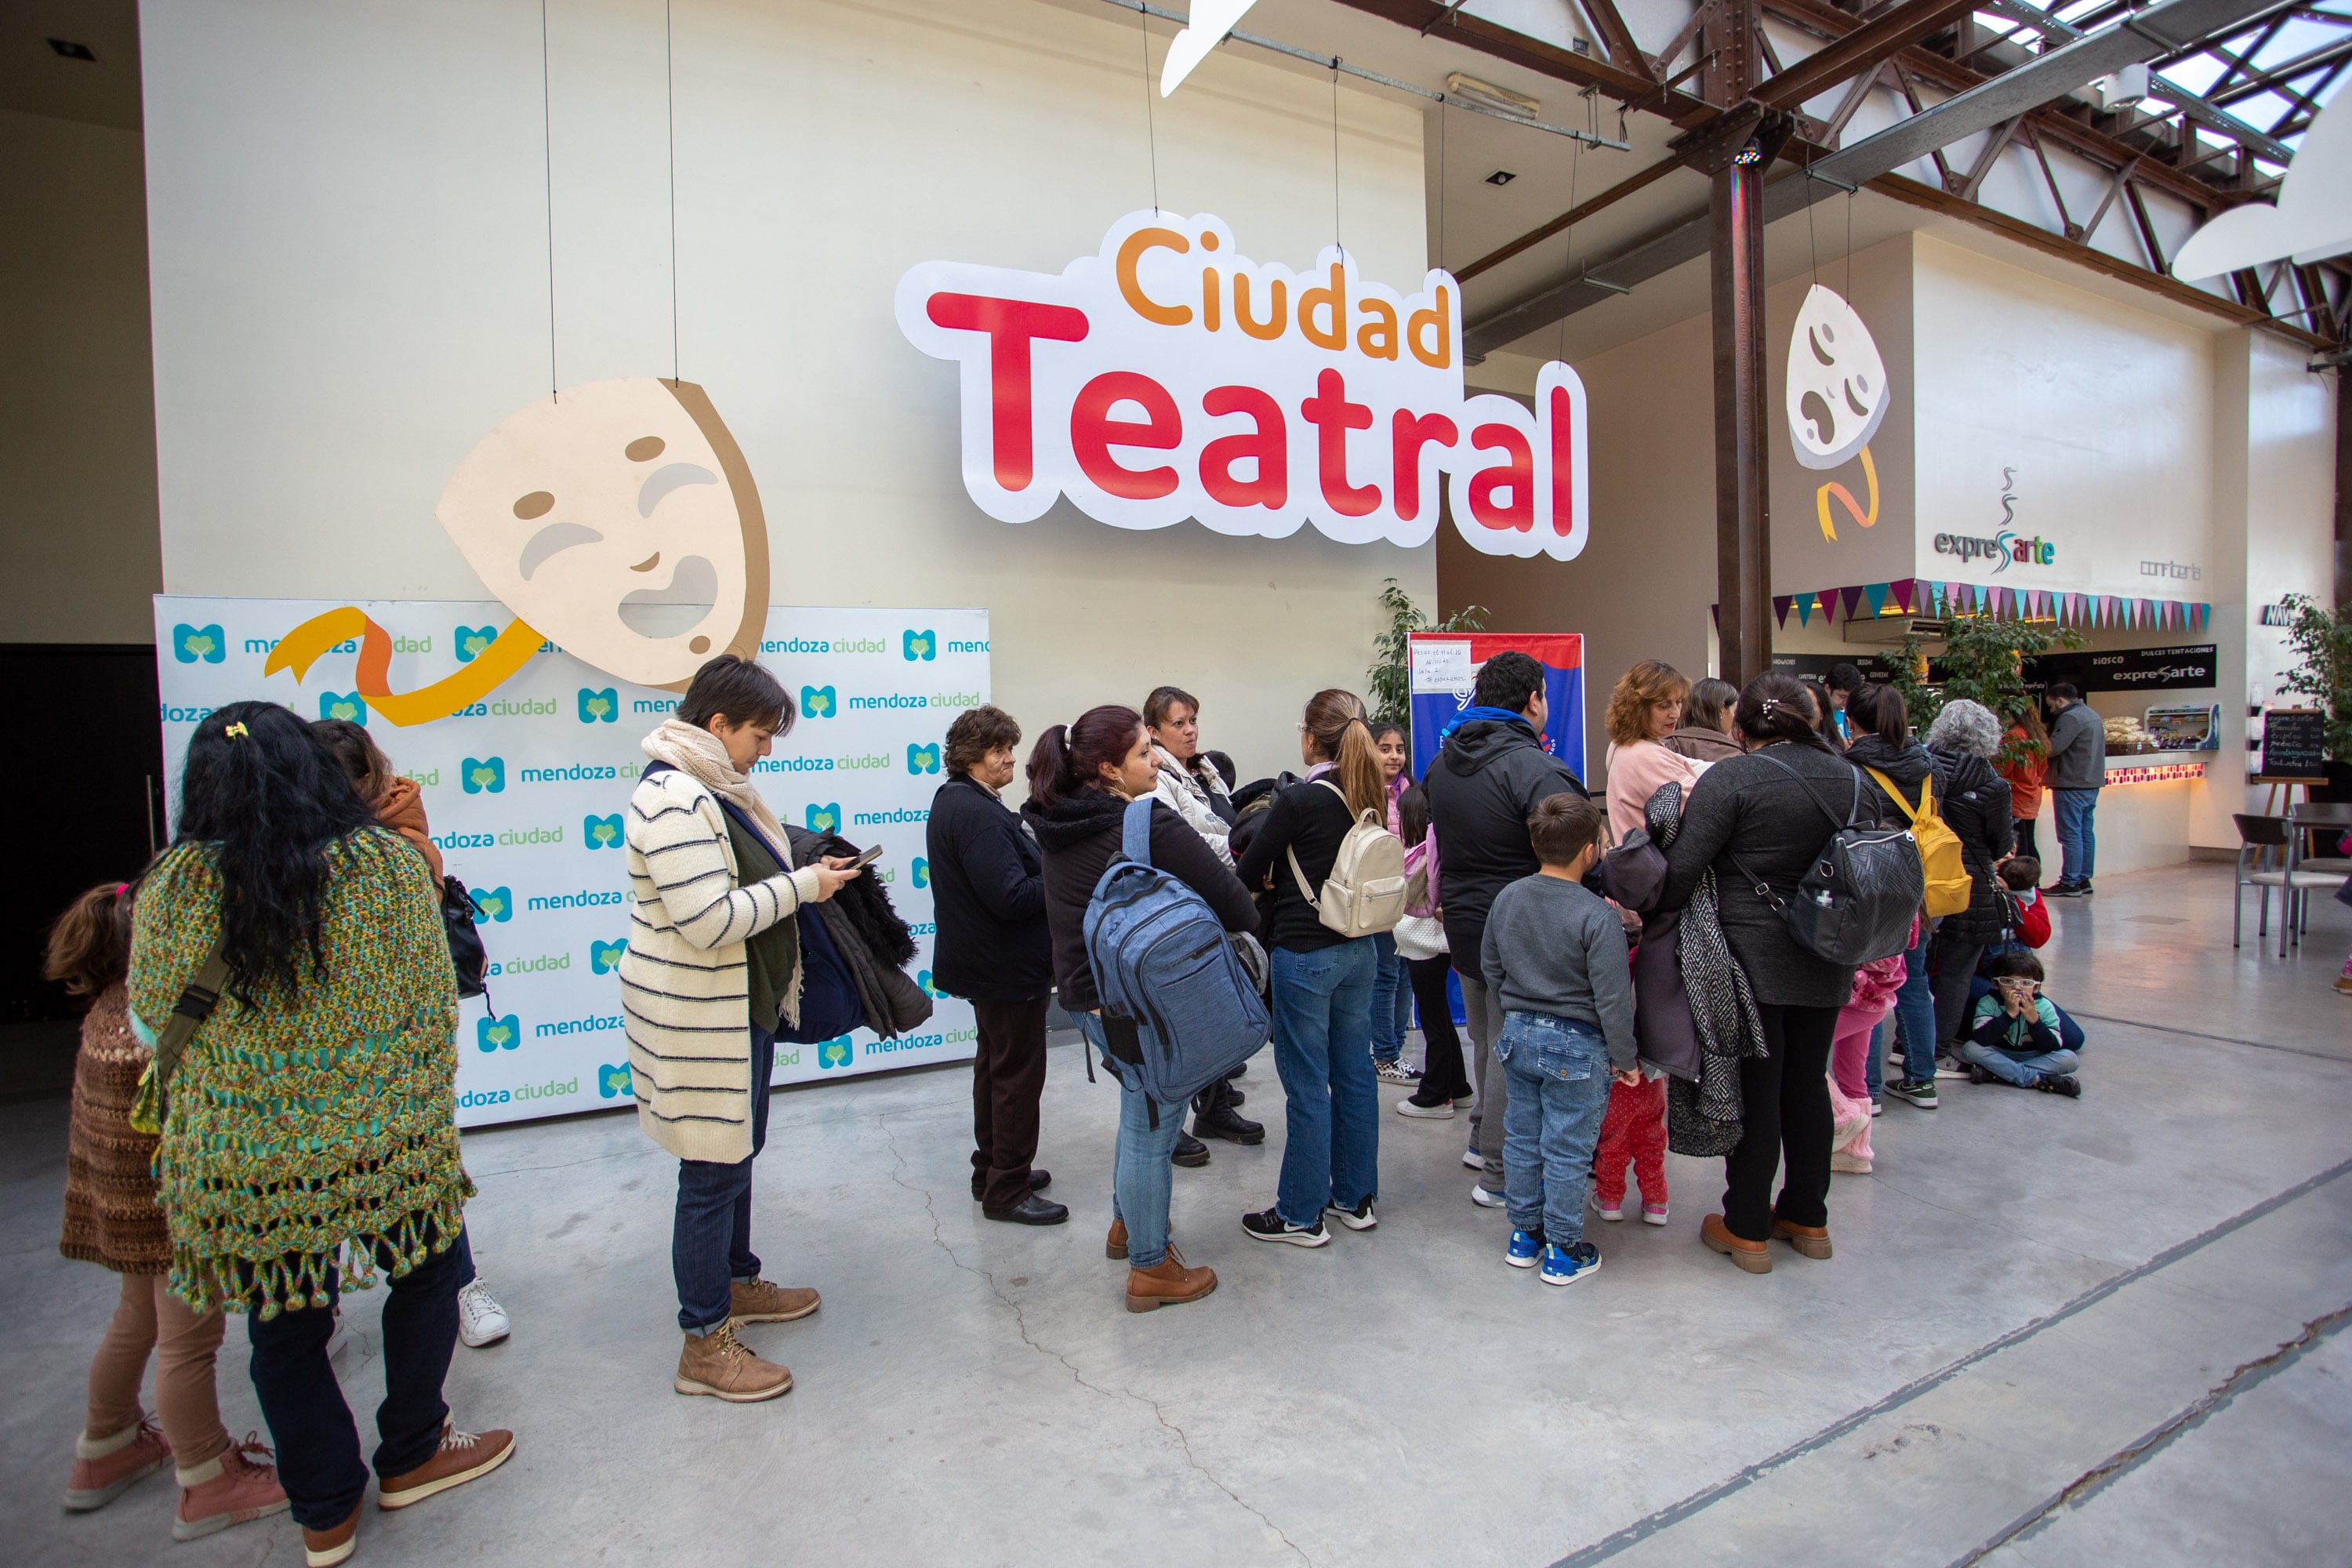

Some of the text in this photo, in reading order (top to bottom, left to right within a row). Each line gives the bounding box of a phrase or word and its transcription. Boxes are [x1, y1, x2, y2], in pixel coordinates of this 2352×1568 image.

[1116, 228, 1450, 368] Ciudad
[927, 292, 1571, 535] Teatral
[833, 639, 885, 652] ciudad
[491, 699, 557, 715] ciudad
[850, 692, 979, 709] mendoza ciudad
[521, 764, 615, 782] mendoza
[751, 753, 890, 773] mendoza ciudad
[497, 826, 563, 846] ciudad
[528, 890, 622, 911] mendoza
[506, 953, 569, 975] ciudad
[866, 1034, 942, 1054] mendoza
[514, 1079, 578, 1101] ciudad
